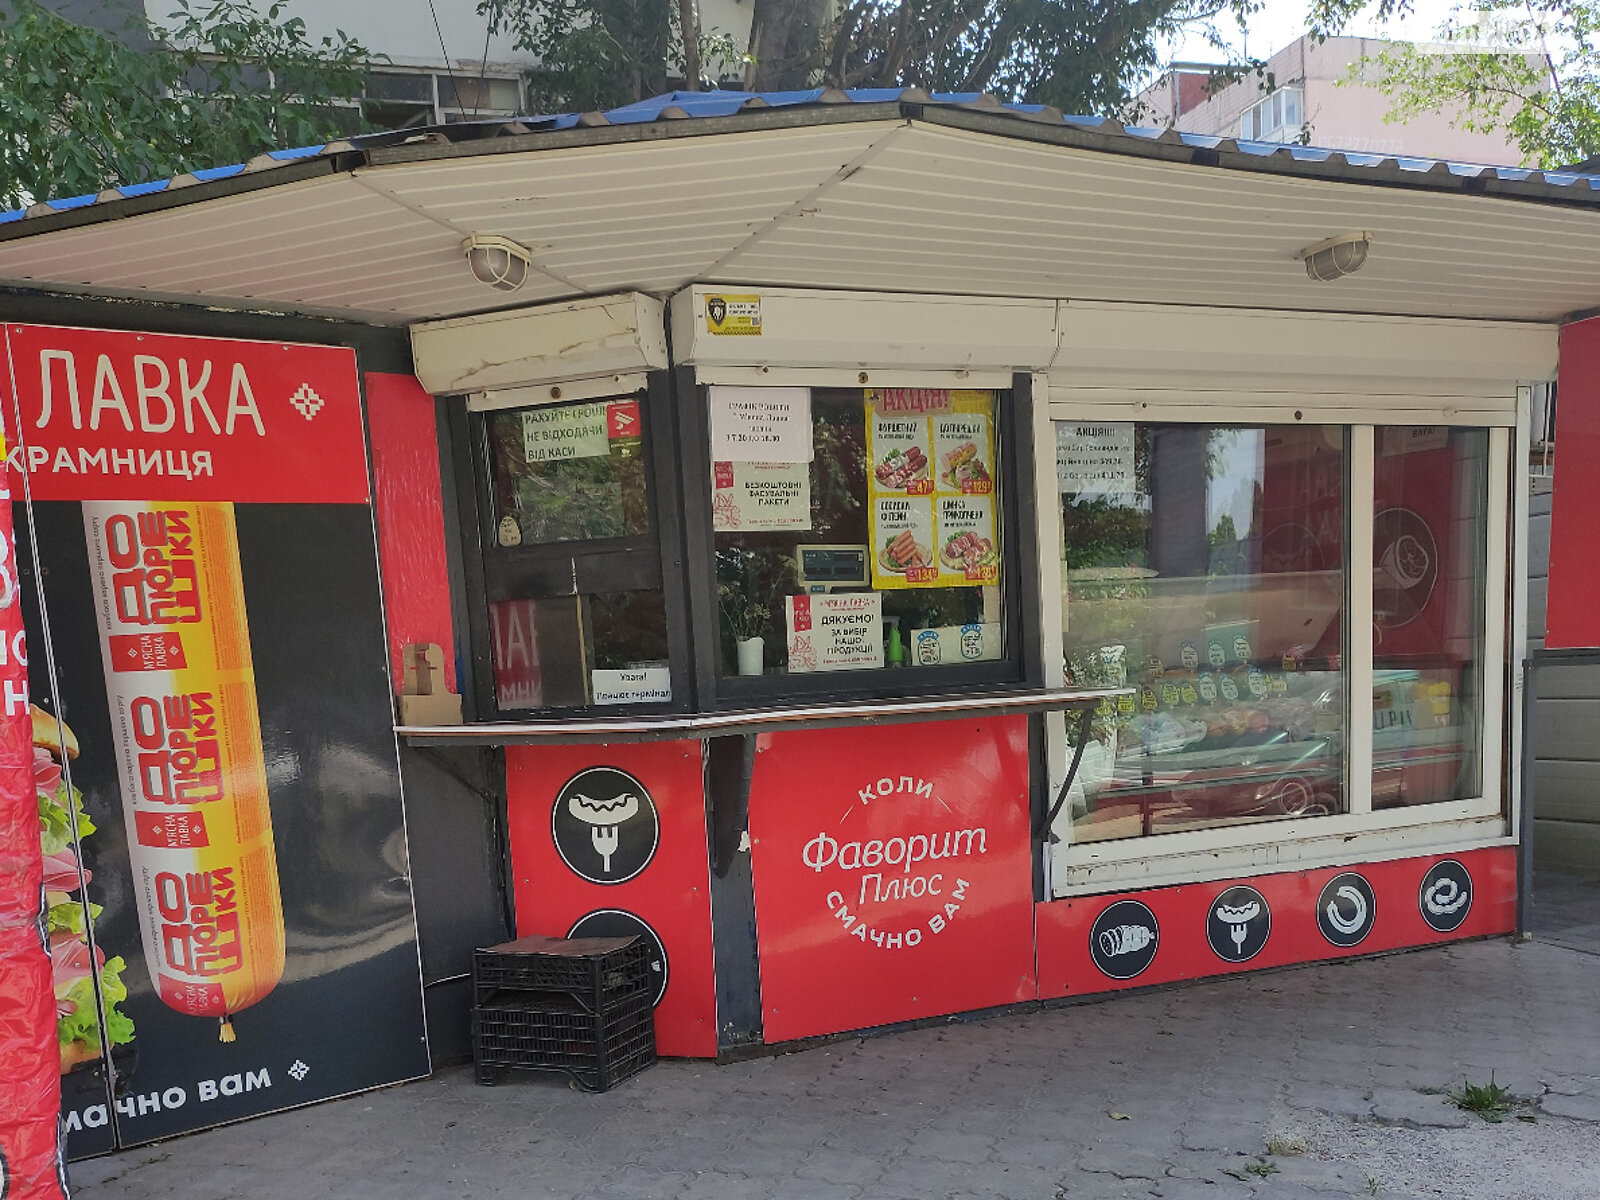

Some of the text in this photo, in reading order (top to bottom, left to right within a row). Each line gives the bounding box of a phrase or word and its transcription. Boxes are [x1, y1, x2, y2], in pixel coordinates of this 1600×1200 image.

[36, 349, 266, 436] ЛАВКА
[525, 410, 570, 424] РАХУЙТЕ
[527, 431, 539, 442] НЕ
[542, 425, 603, 441] ВІДХОДЯЧИ
[5, 446, 213, 480] КРАМНИЦЯ
[528, 447, 576, 460] ВІД КАСИ
[745, 481, 802, 489] БЕЗКОШТОВНІ
[758, 498, 790, 506] ПАКЕТИ
[105, 515, 152, 624] ДО
[137, 511, 177, 623] ПЮРЕ
[822, 614, 874, 626] ДЯКУЄМО!
[155, 637, 167, 667] ЛАВКА
[131, 697, 178, 805] ДО
[164, 694, 203, 804] ПЮРЕ
[858, 776, 933, 805] КОЛИ
[802, 828, 987, 873] Фаворит
[859, 873, 943, 904] Плюс
[154, 871, 198, 976] ДО
[185, 871, 223, 976] ПЮРЕ
[826, 878, 969, 948] СМАЧНО ВАМ
[198, 1067, 272, 1102] вам
